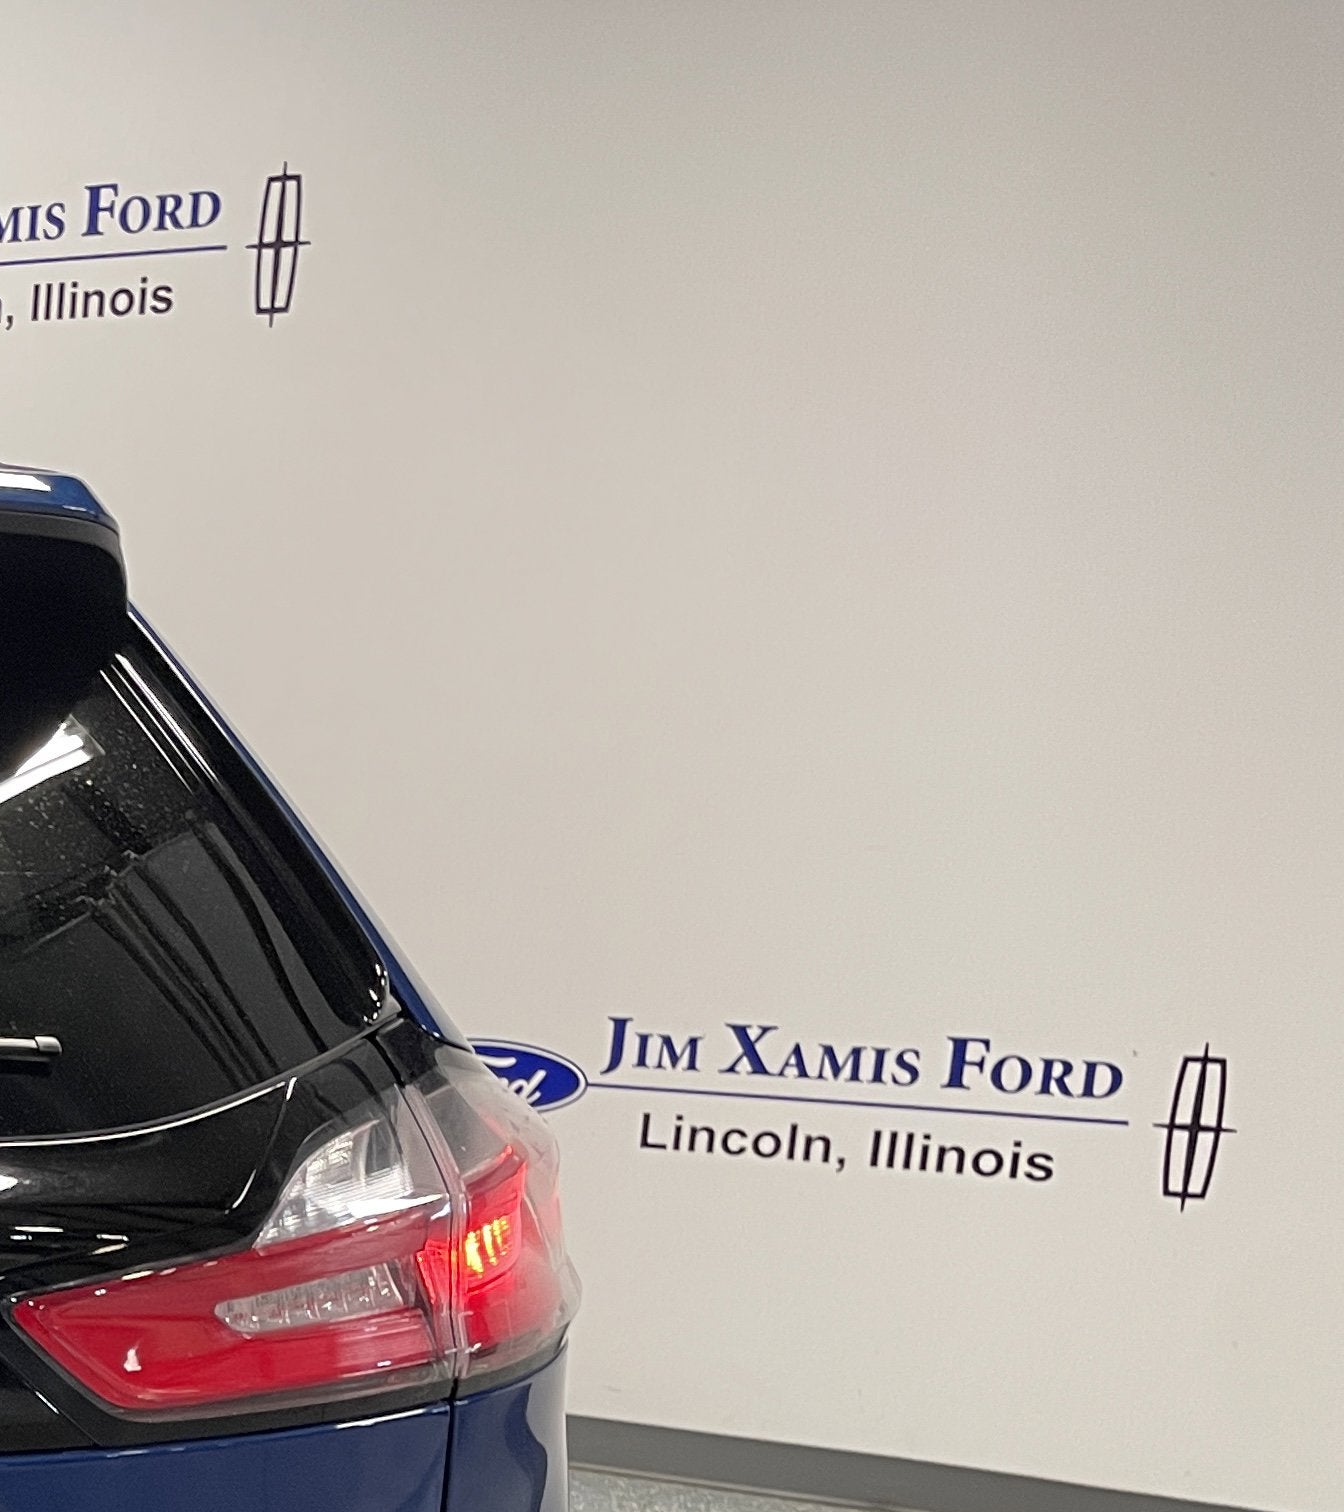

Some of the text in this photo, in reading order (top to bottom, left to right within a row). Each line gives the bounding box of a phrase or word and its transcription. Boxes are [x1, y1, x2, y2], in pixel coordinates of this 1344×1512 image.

[81, 183, 221, 236] FORD
[31, 276, 173, 322] Illinois
[599, 1016, 1123, 1099] JIM XAMIS FORD
[639, 1112, 1054, 1182] Lincoln, Illinois
